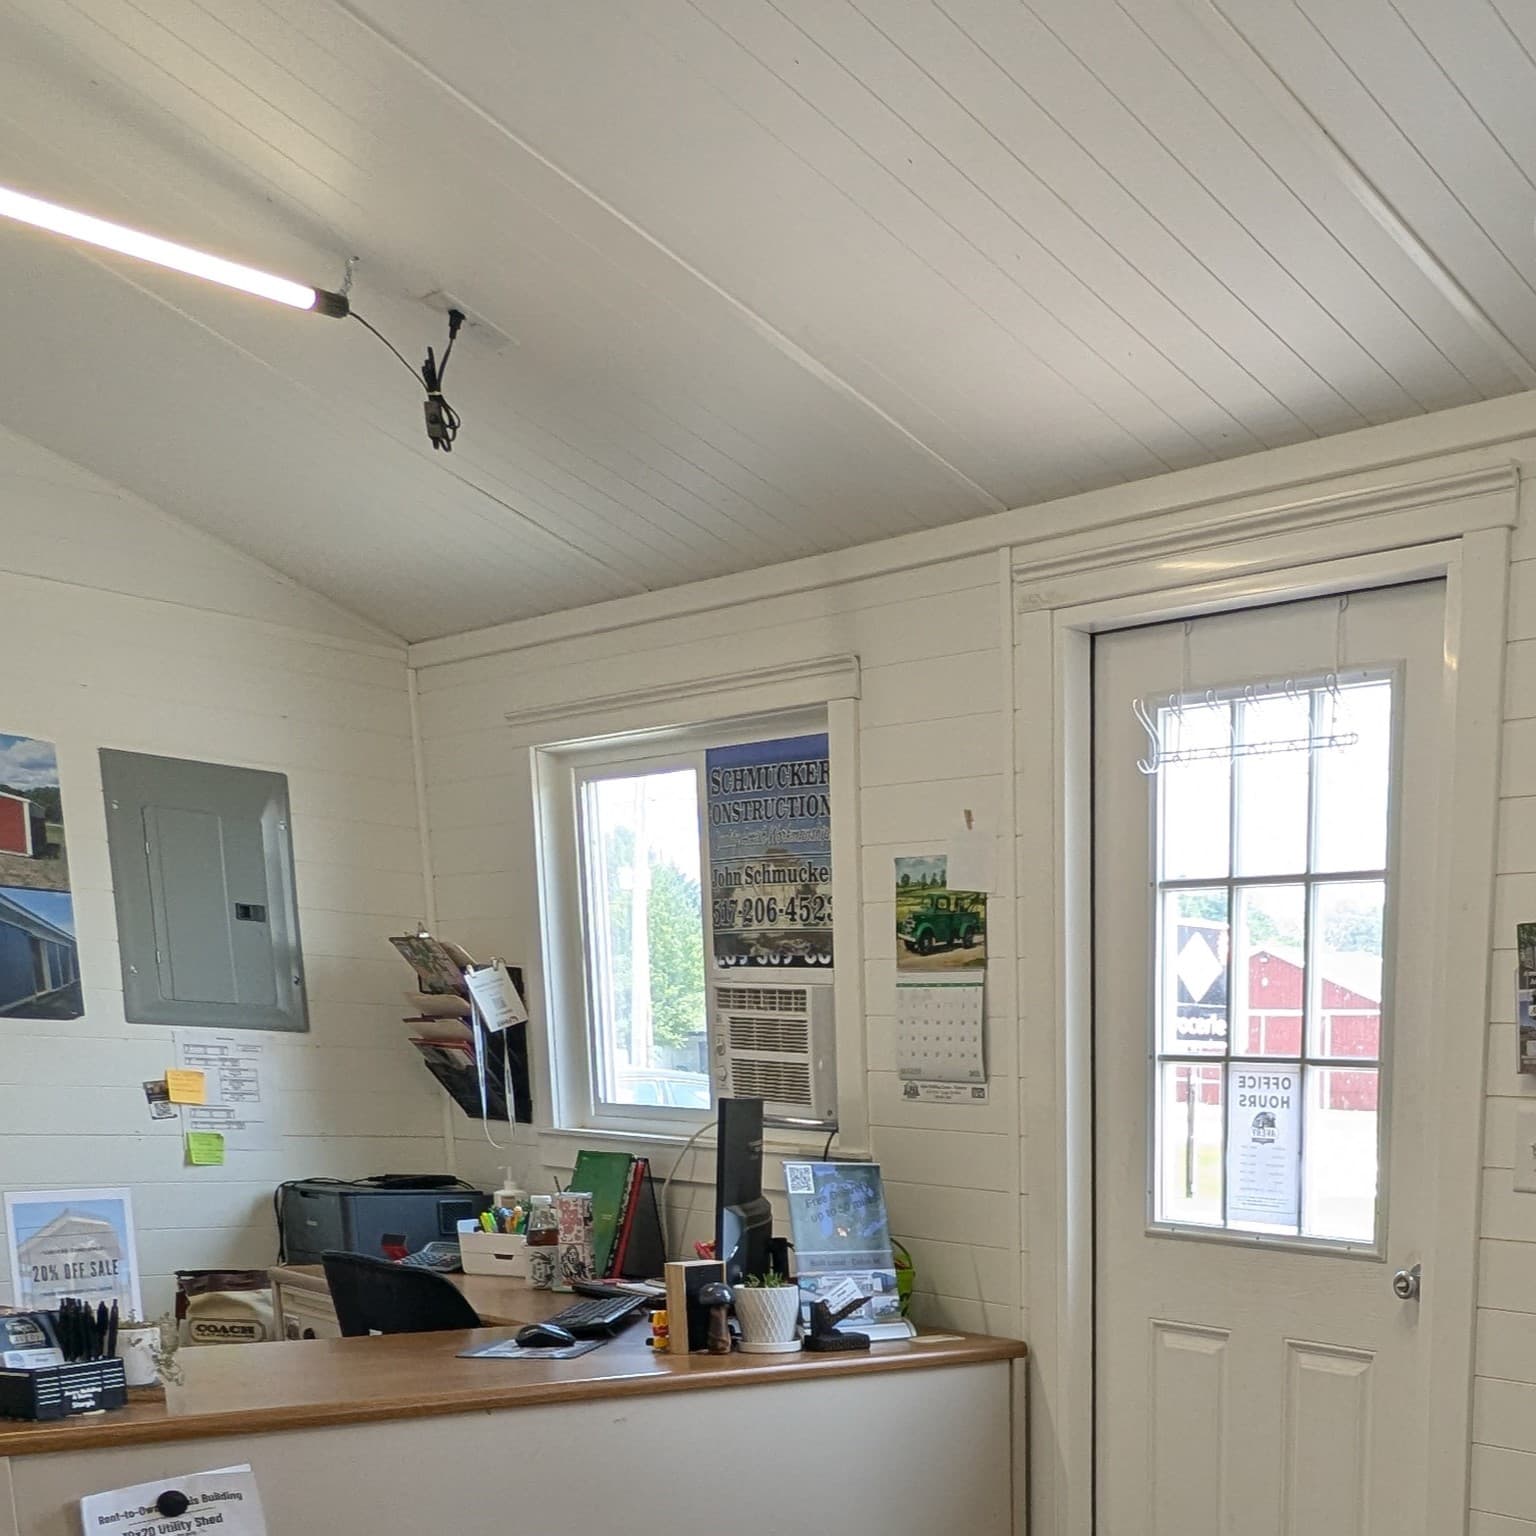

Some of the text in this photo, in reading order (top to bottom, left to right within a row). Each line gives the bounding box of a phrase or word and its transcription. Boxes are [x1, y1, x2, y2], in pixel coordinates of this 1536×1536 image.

[711, 760, 829, 796] SCHMUCKER
[710, 794, 830, 825] ONSTRUCTION
[713, 861, 832, 888] John Schmucke
[32, 1259, 119, 1282] 20% OFF SALE
[201, 1490, 243, 1504] Building
[158, 1520, 192, 1535] Utility
[195, 1513, 224, 1527] Shed
